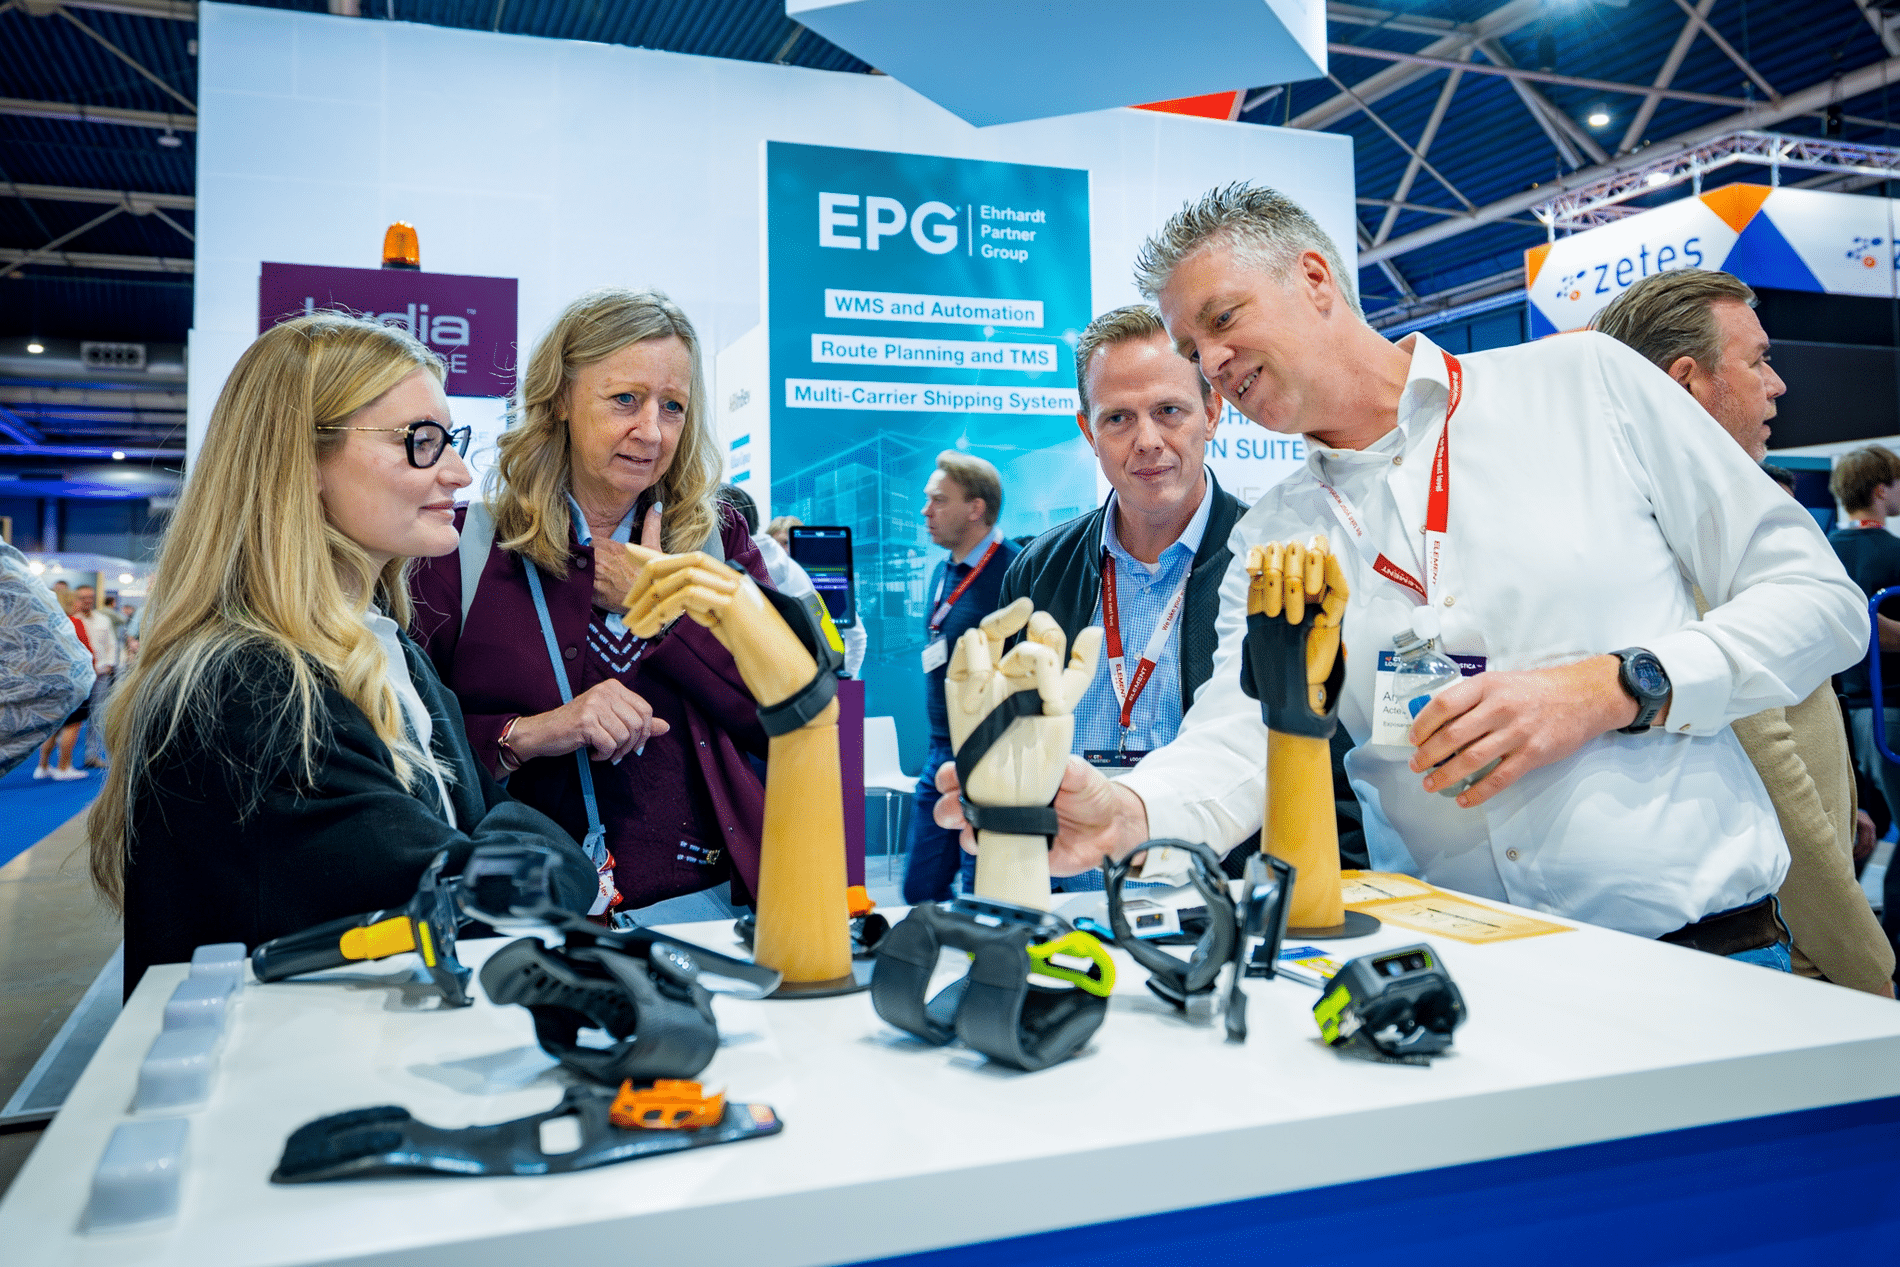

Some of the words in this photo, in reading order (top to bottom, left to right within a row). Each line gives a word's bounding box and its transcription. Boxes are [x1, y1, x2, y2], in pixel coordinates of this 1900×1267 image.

[818, 191, 959, 255] EPG
[980, 205, 1046, 224] Ehrhardt
[981, 225, 1037, 242] Partner
[981, 244, 1029, 263] Group
[1594, 236, 1704, 294] zetes
[835, 296, 885, 314] WMS
[891, 298, 925, 317] and
[931, 302, 1035, 322] Automation
[821, 341, 878, 359] Route
[885, 344, 965, 365] Planning
[971, 347, 1004, 364] and
[1010, 349, 1050, 365] TMS
[795, 386, 917, 406] Multi-Carrier
[924, 390, 1003, 411] Shipping
[1236, 438, 1305, 461] SUITE
[1129, 667, 1147, 701] ELEMENT
